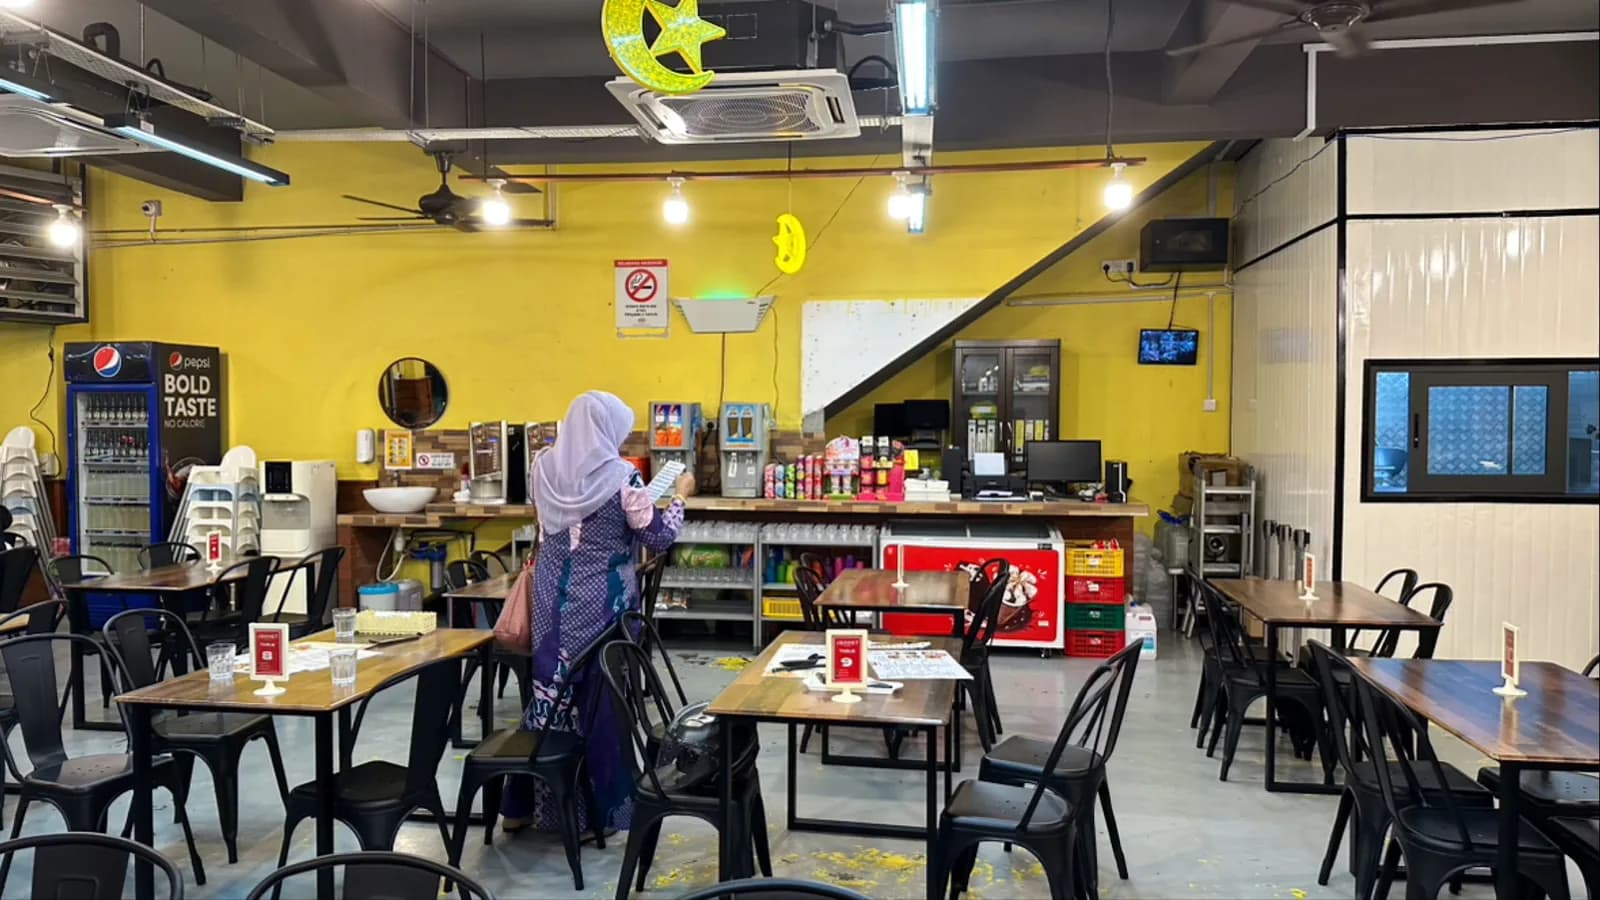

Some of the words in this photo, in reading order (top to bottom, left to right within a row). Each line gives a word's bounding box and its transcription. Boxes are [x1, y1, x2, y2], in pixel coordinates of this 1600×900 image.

[184, 357, 210, 369] pepsi
[164, 373, 211, 394] BOLD
[163, 397, 217, 417] TASTE
[164, 419, 176, 428] NO
[840, 657, 853, 668] 9
